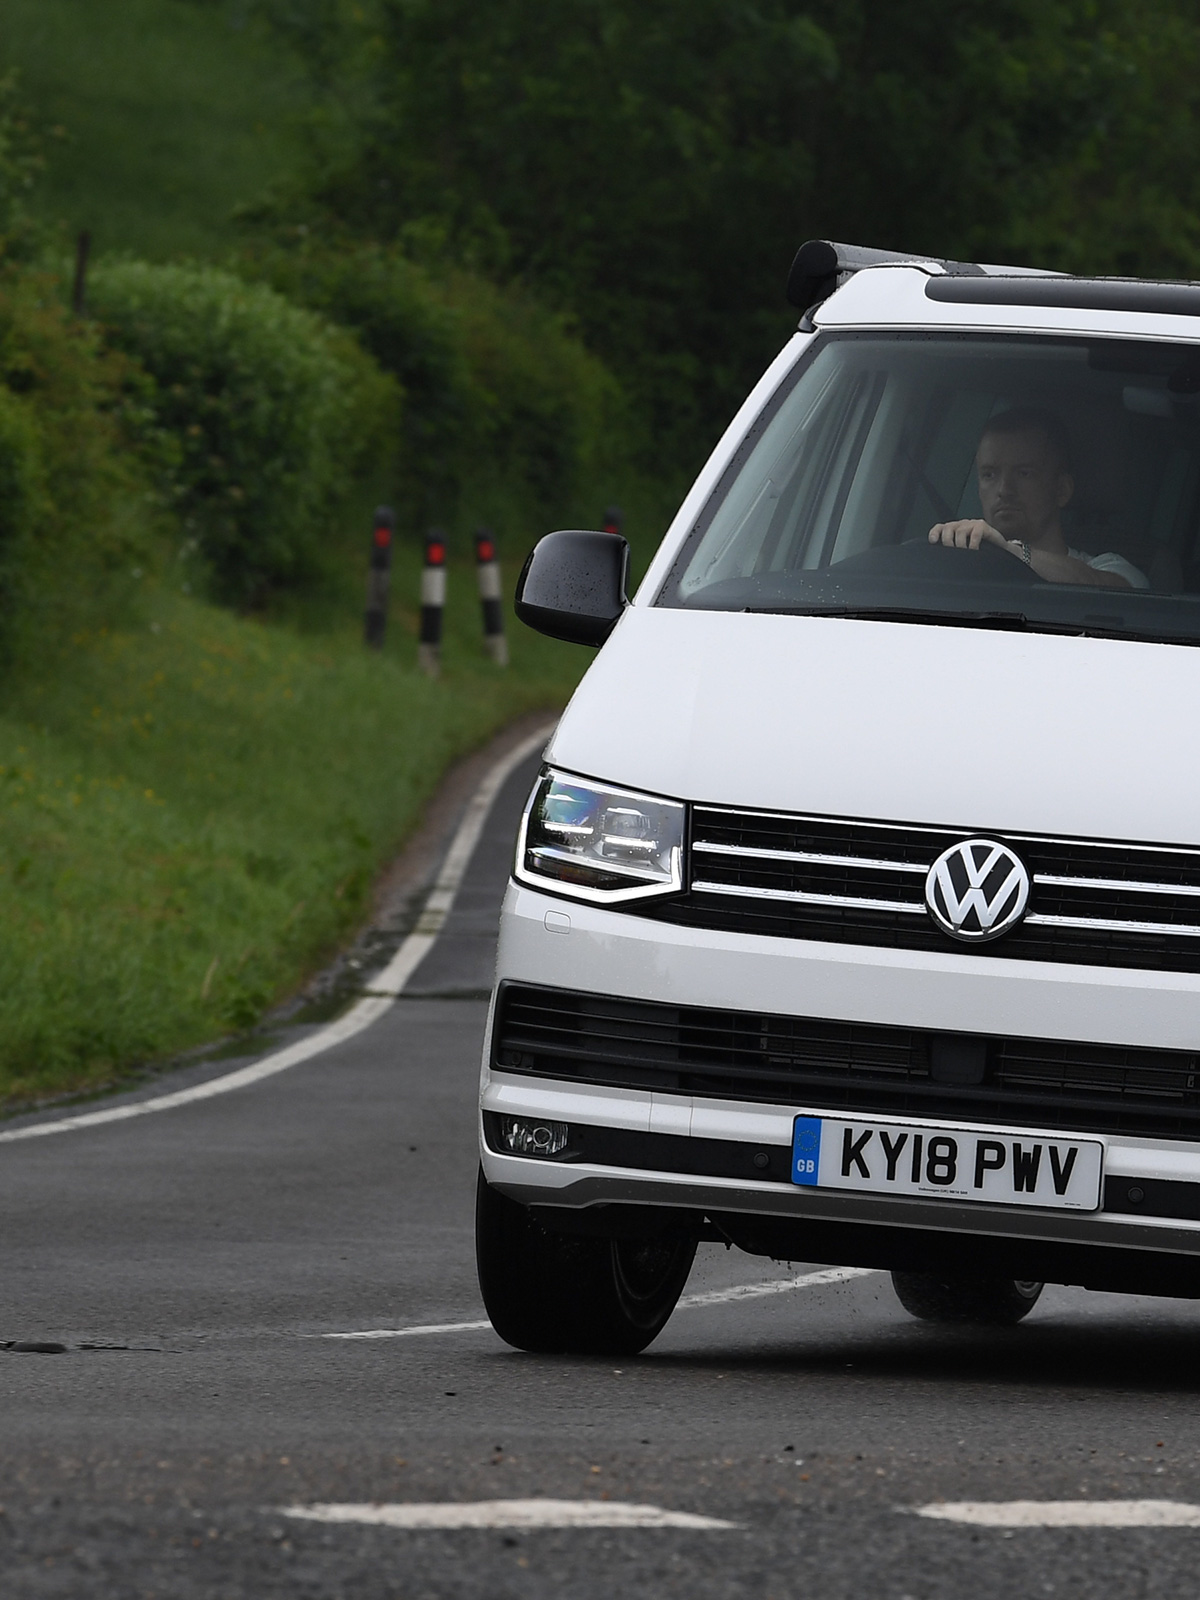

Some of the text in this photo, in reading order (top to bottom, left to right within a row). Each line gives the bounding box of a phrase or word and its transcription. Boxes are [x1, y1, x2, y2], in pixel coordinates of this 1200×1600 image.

[926, 839, 1029, 936] VW
[796, 1158, 815, 1174] GB
[841, 1127, 1080, 1196] KY18 PWV
